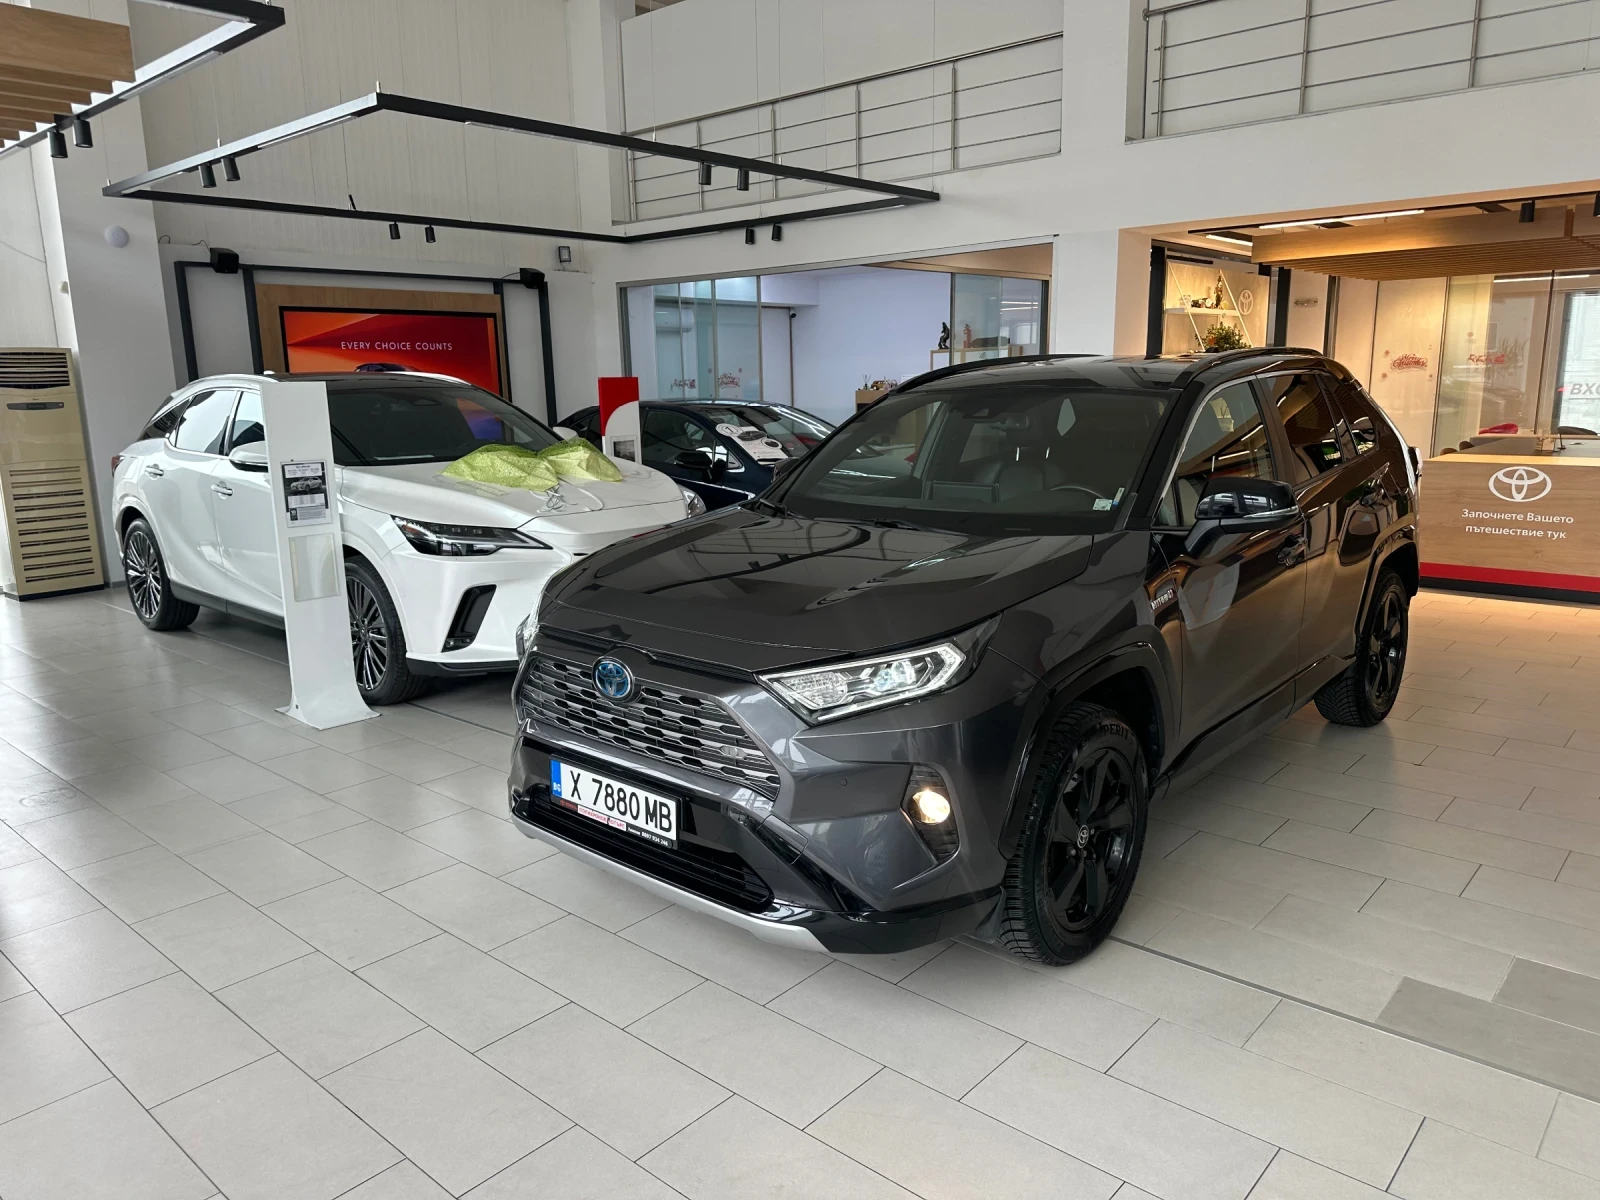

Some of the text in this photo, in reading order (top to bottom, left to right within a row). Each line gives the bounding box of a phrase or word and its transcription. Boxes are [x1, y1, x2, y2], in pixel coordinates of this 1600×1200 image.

[341, 341, 453, 351] EVERY CHOICE COUNTS
[1461, 508, 1574, 524] Започнете Вашето
[1465, 525, 1566, 540] пътешествие тук
[553, 782, 562, 792] BG
[570, 770, 672, 833] X 7880 MB
